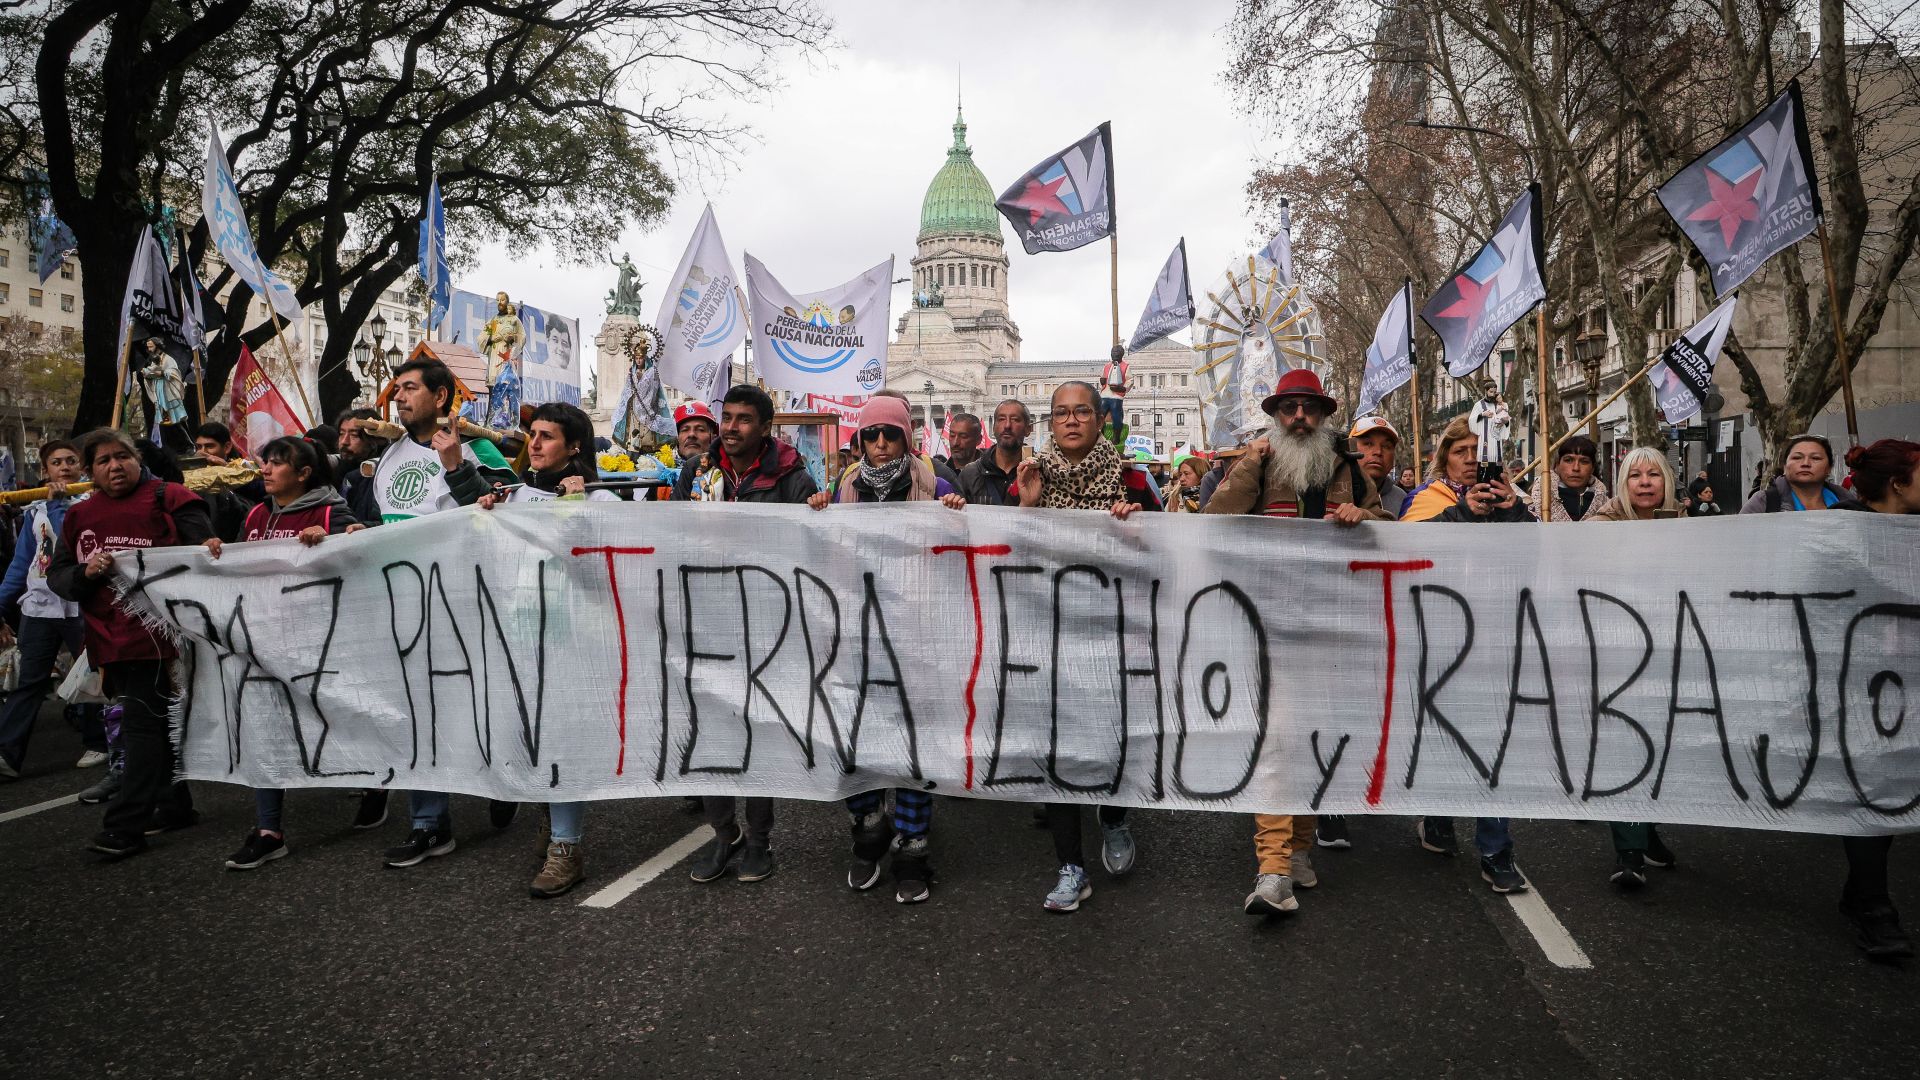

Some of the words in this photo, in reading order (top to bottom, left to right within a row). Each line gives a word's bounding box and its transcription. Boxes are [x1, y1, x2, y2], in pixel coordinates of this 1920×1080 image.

[764, 322, 802, 343] CAUSA
[805, 332, 865, 348] NACIONAL
[776, 314, 834, 335] PEREGRINOS
[387, 499, 405, 511] LIBERAR
[406, 501, 413, 509] LA
[104, 536, 153, 547] AGRUPACION
[932, 544, 1272, 803] TECHO
[1349, 558, 1920, 817] TRABAJO
